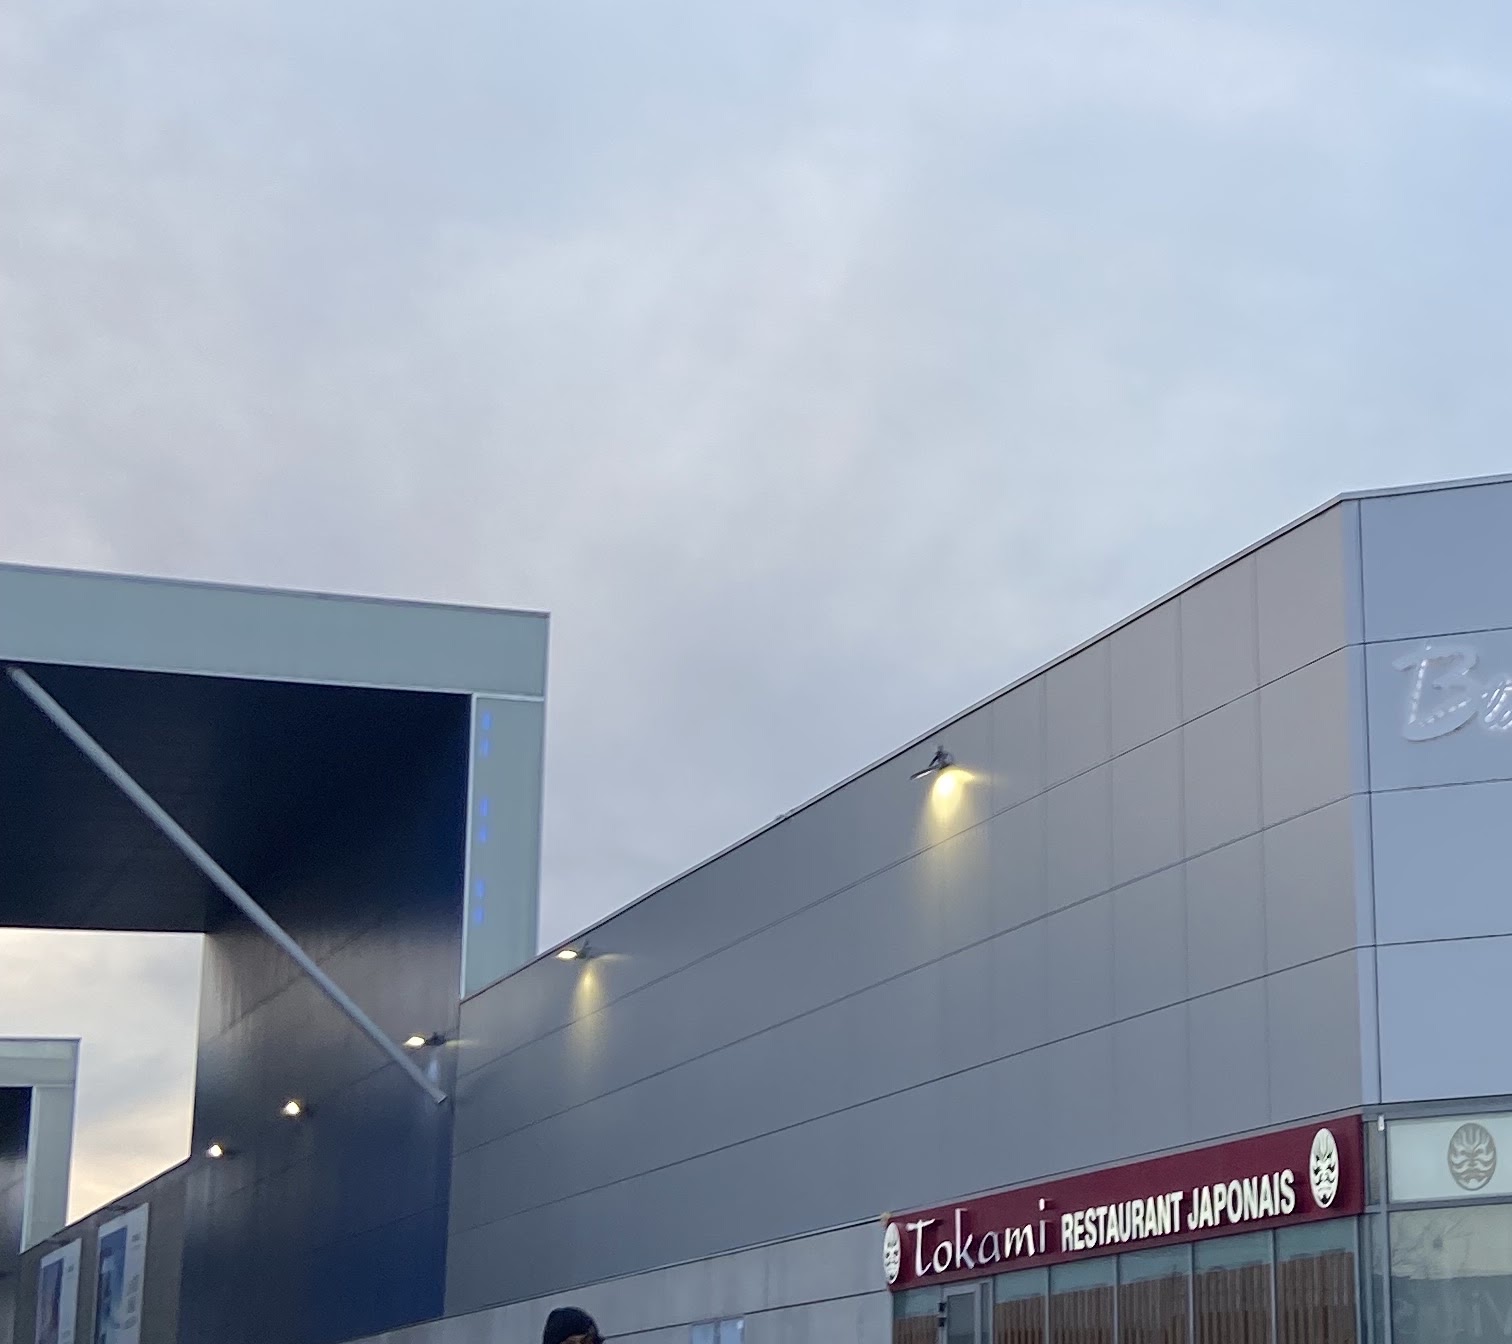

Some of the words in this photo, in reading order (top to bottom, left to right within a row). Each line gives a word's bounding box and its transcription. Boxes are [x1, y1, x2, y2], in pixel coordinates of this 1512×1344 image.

[905, 1198, 1051, 1277] Tokami
[1061, 1191, 1184, 1253] RESTAURANT
[1187, 1168, 1296, 1231] JAPONAIS
